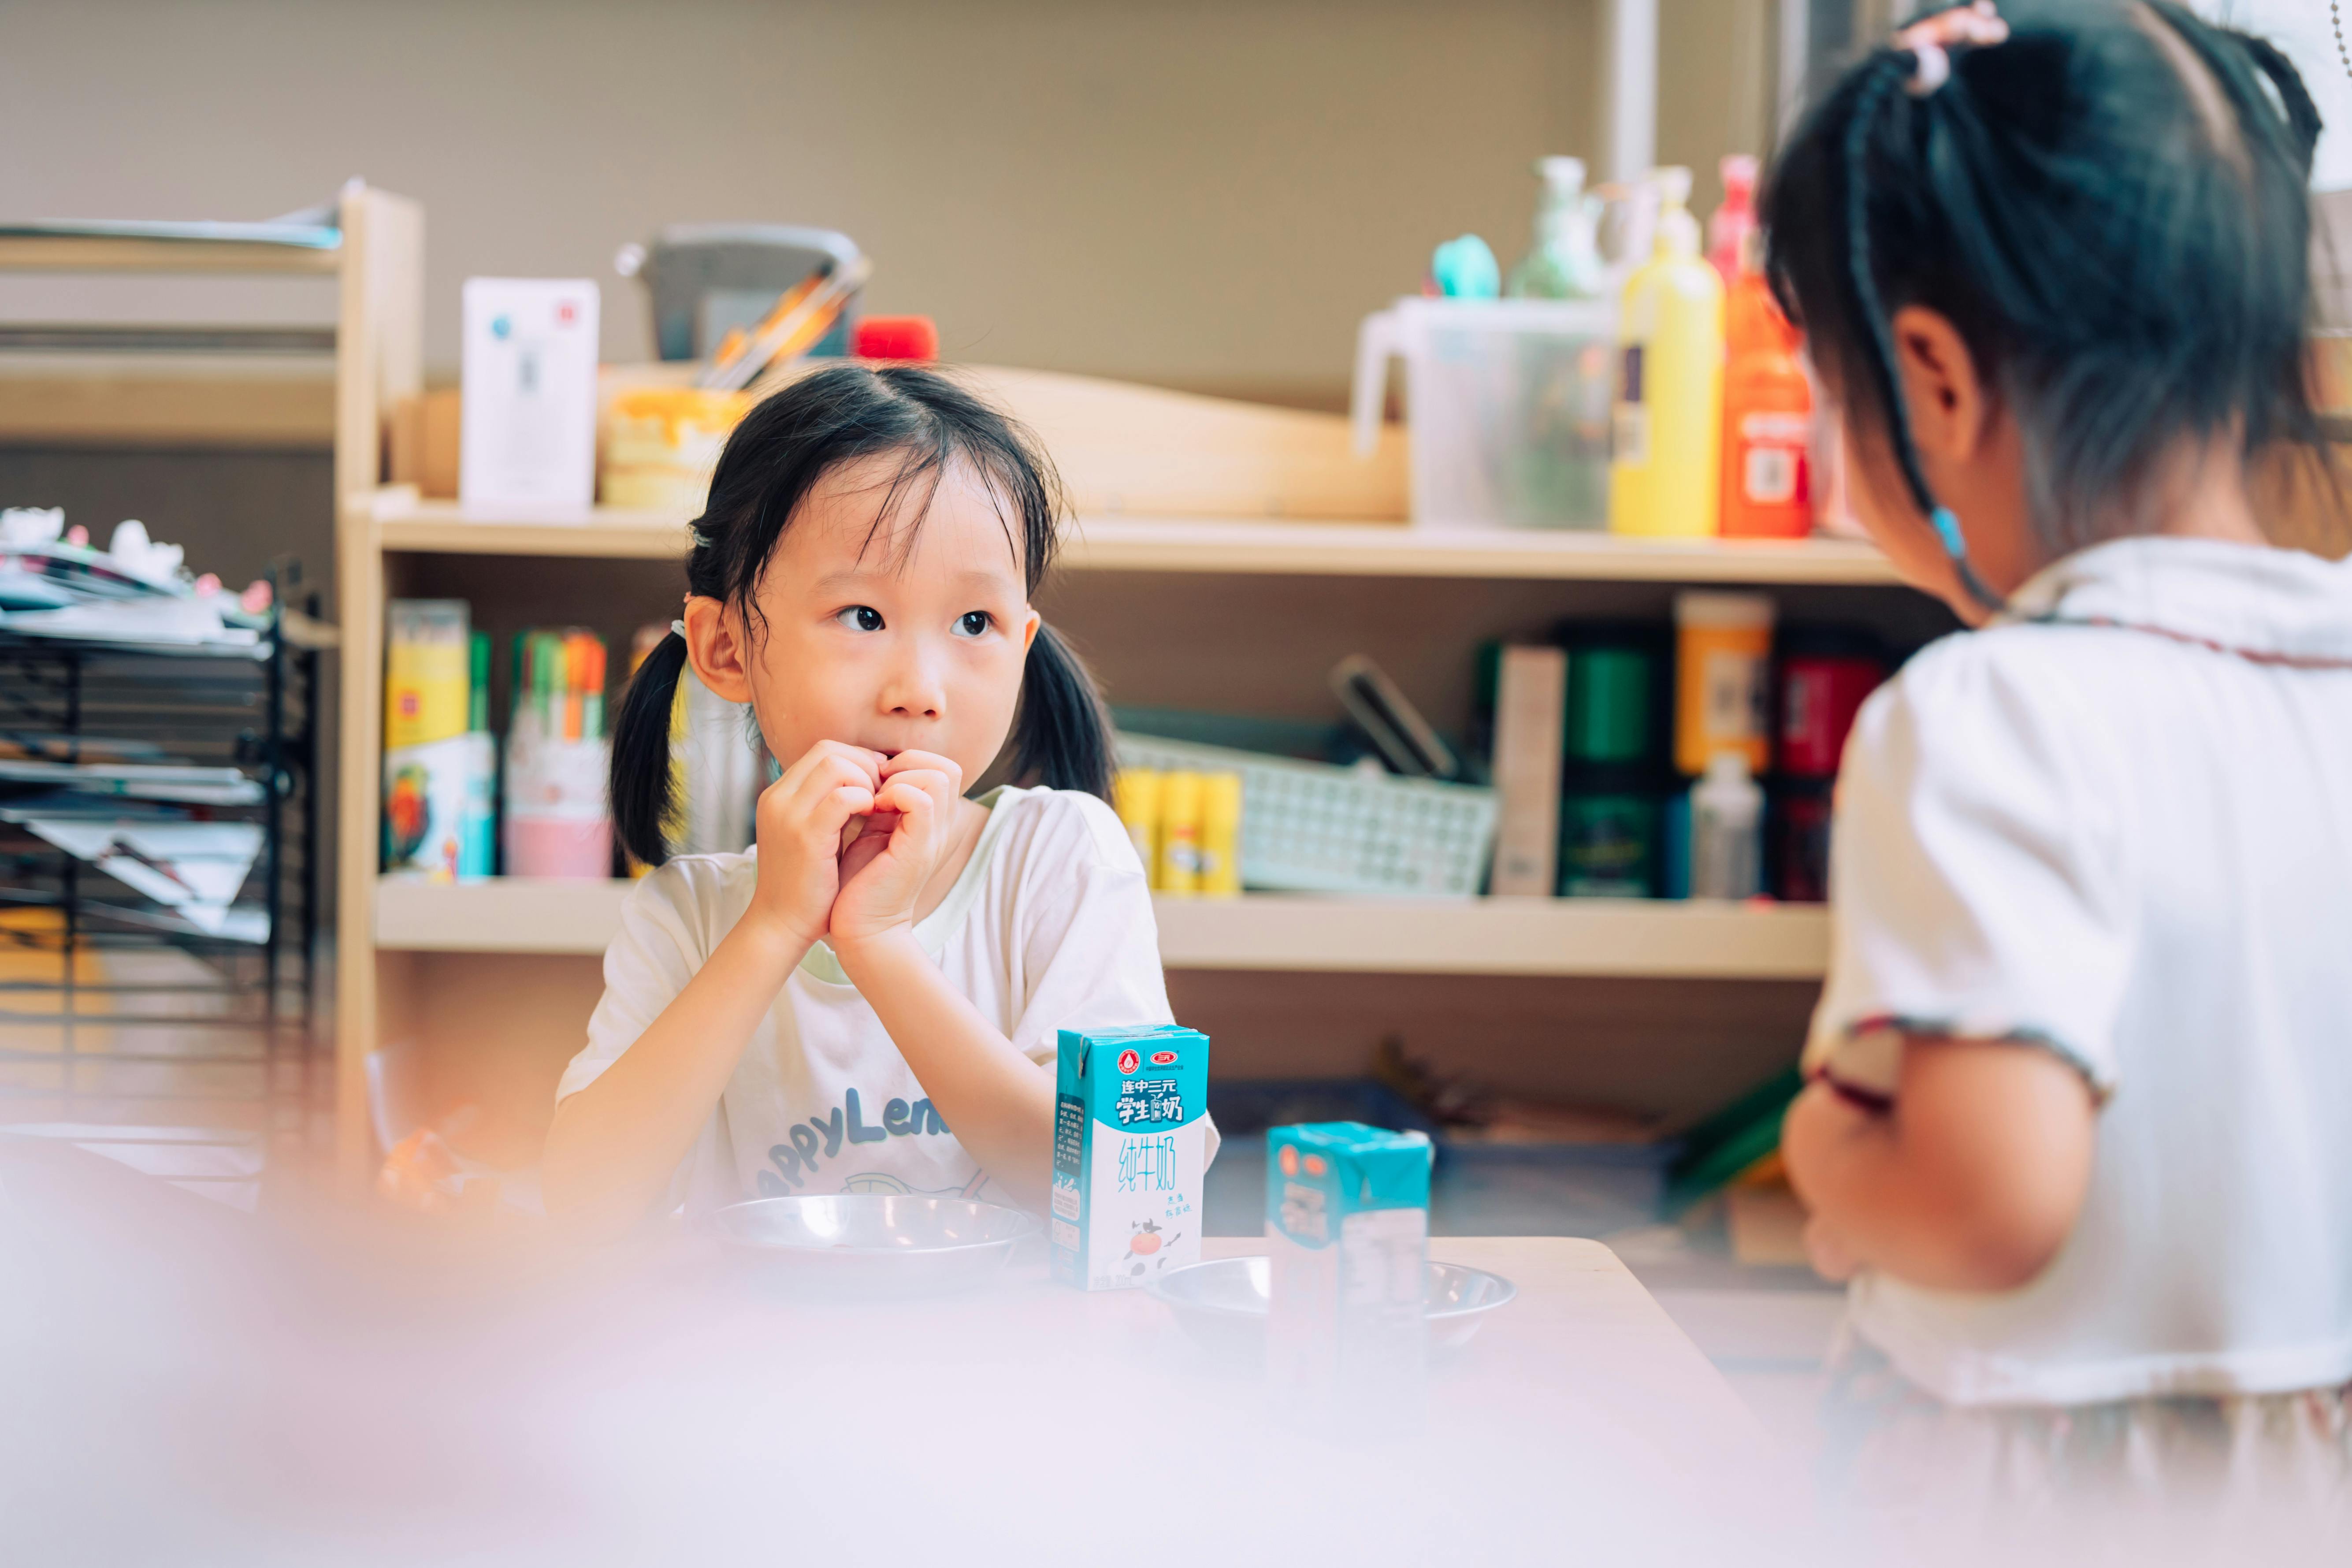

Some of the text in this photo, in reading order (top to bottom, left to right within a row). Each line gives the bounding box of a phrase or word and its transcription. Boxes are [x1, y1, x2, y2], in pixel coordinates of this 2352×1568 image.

[1122, 1080, 1176, 1094] 连中三元
[1118, 1136, 1175, 1193] 纯牛奶
